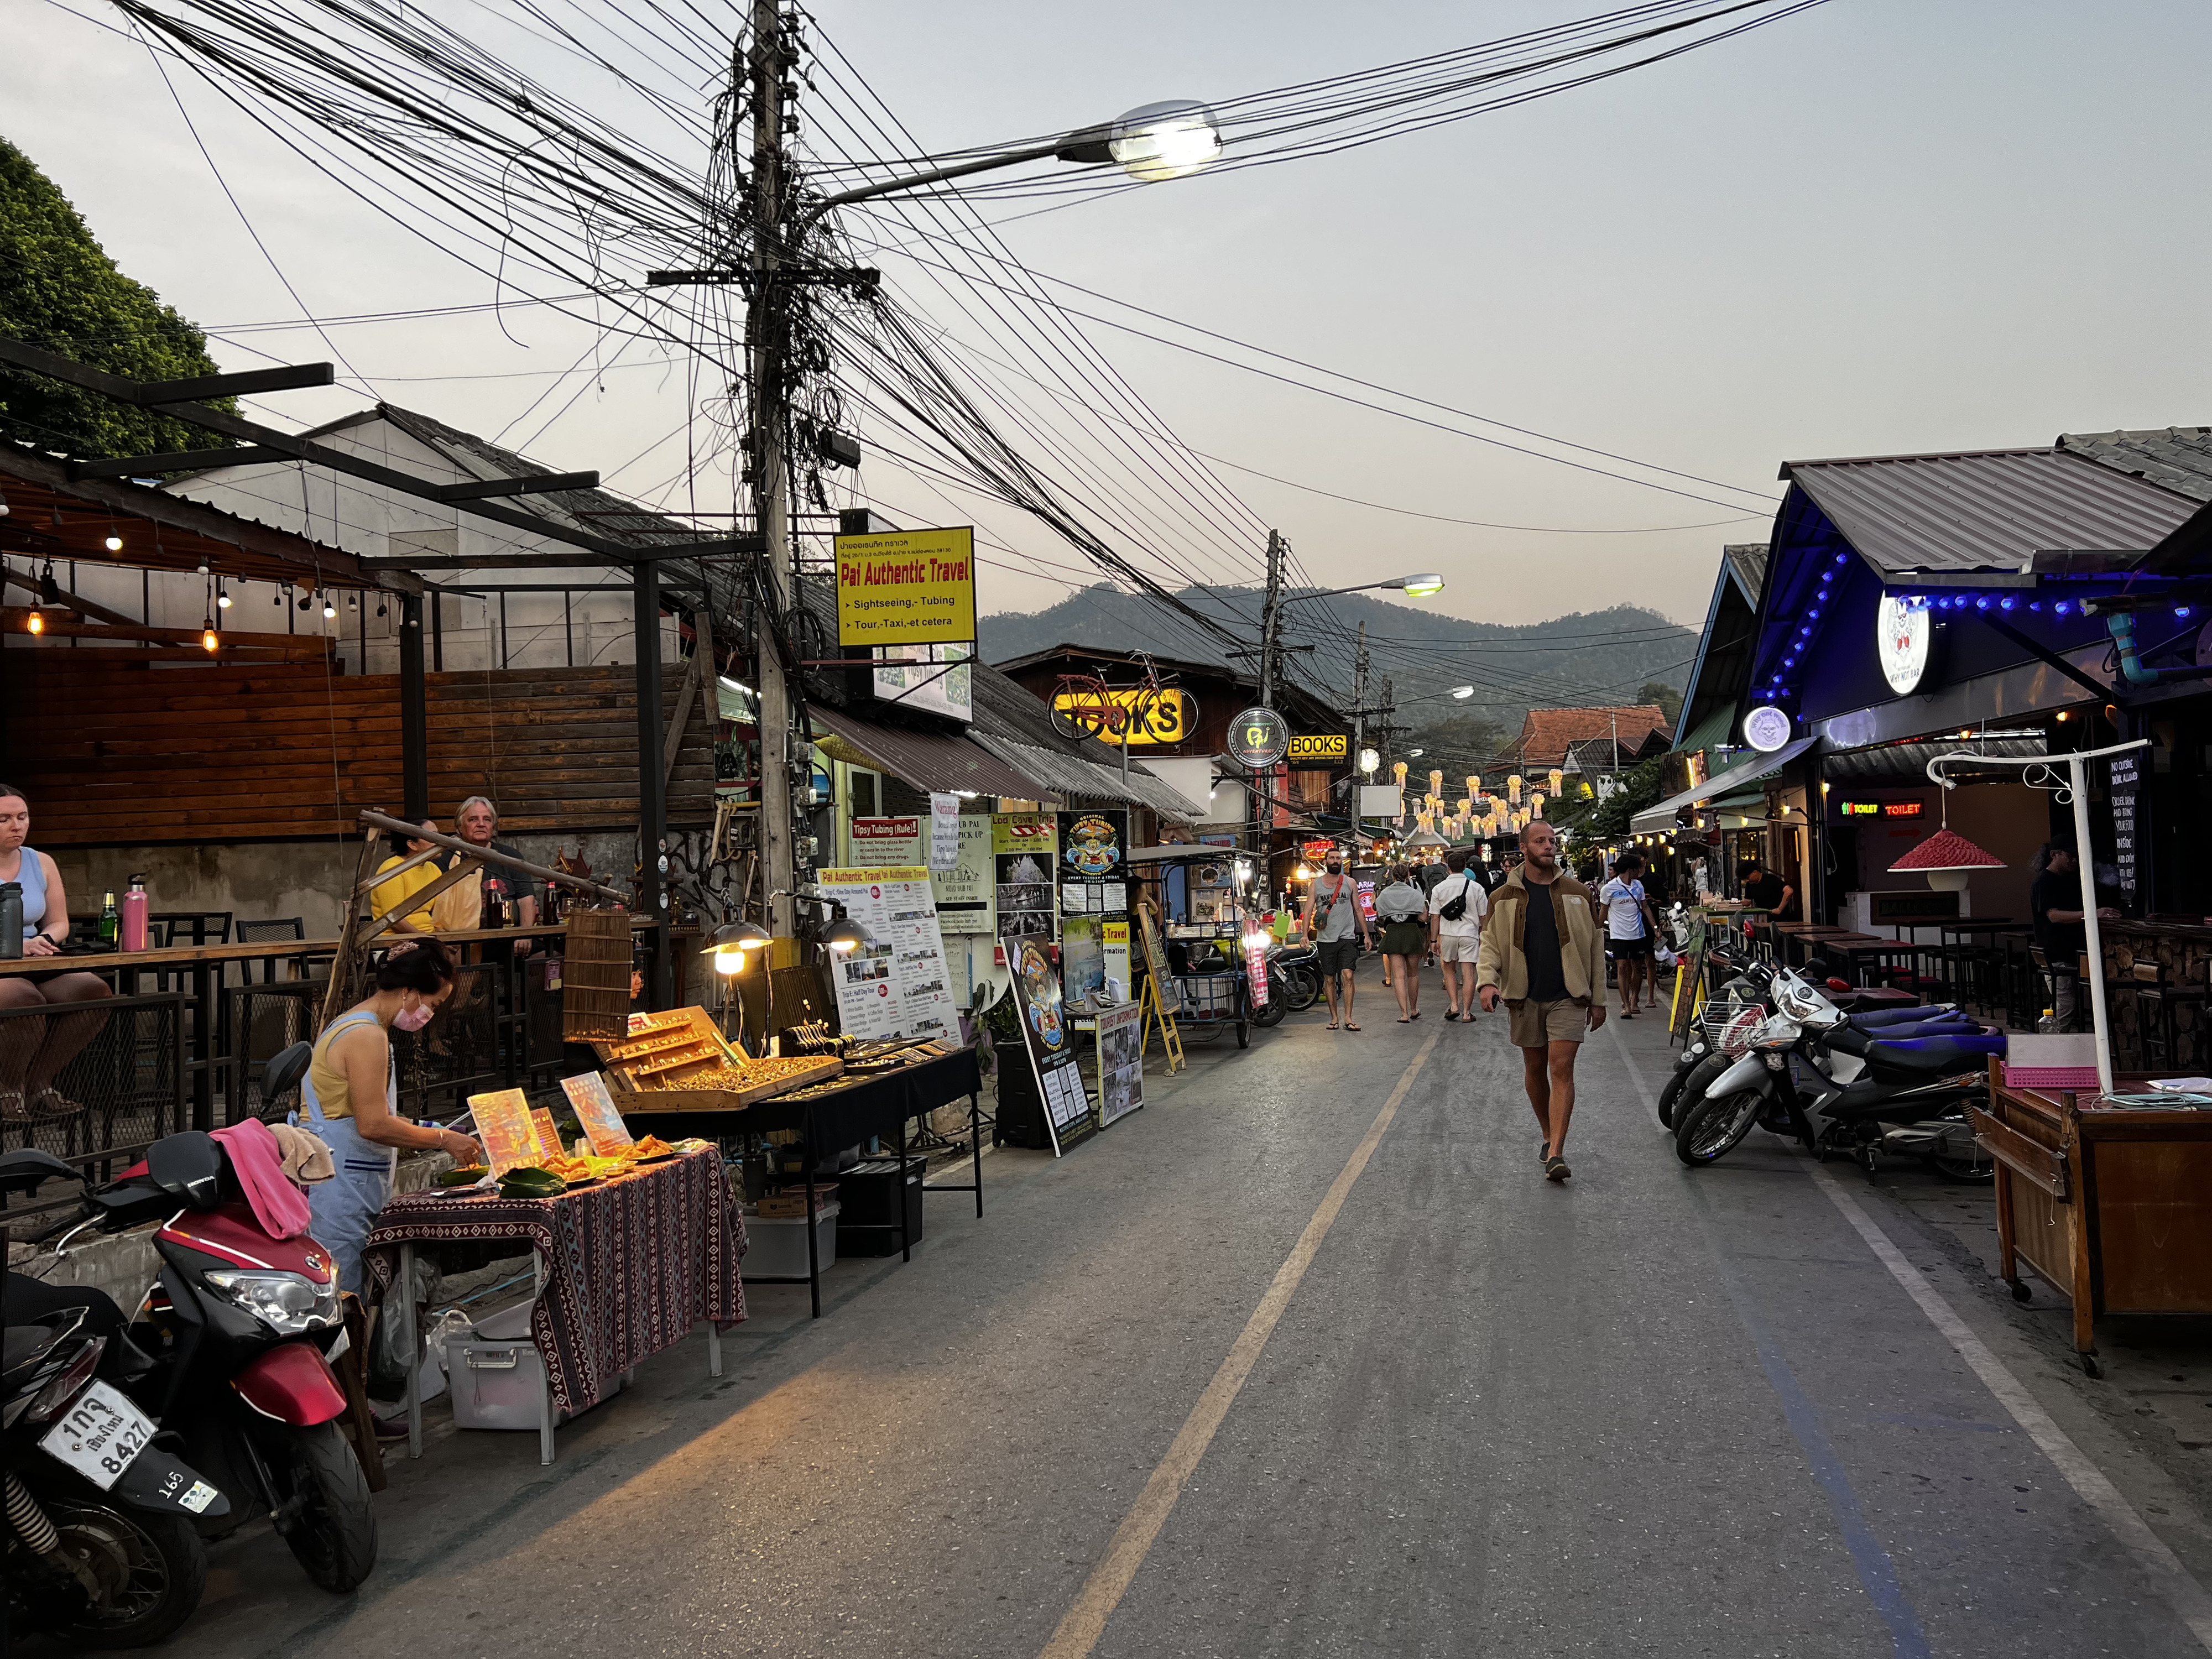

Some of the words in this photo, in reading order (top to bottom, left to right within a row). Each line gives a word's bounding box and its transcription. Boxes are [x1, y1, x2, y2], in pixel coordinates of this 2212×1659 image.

[841, 562, 860, 587] Pai
[864, 559, 925, 586] Authentic
[930, 556, 968, 582] Travel
[921, 596, 955, 607] Tubing
[922, 618, 952, 626] cetera
[1890, 672, 1900, 684] WHY
[1901, 670, 1910, 681] NOT
[1911, 668, 1919, 679] BAR
[1291, 737, 1344, 753] BOOKS
[2111, 761, 2118, 772] NO
[934, 801, 958, 819] Warning!
[1854, 804, 1878, 813] TOILET
[1885, 804, 1921, 816] TOILET
[1013, 816, 1033, 824] Cave
[1037, 815, 1055, 823] Trip
[854, 825, 871, 837] Tipsy
[871, 824, 894, 836] Tubing
[895, 821, 916, 834] (Rule)!
[1089, 818, 1116, 834] TUBING
[1303, 841, 1334, 849] PIZZA
[822, 872, 833, 882] Pai
[835, 871, 863, 882] Authentic
[864, 870, 881, 881] Travel
[890, 870, 912, 879] Authentic
[913, 869, 928, 878] Travel
[1107, 928, 1126, 939] Travel
[1100, 1014, 1116, 1031] TOURIST
[1117, 1007, 1140, 1024] INFORMATION
[187, 1176, 216, 1188] HONDA
[101, 1421, 148, 1474] 8427
[159, 1471, 184, 1499] 165
